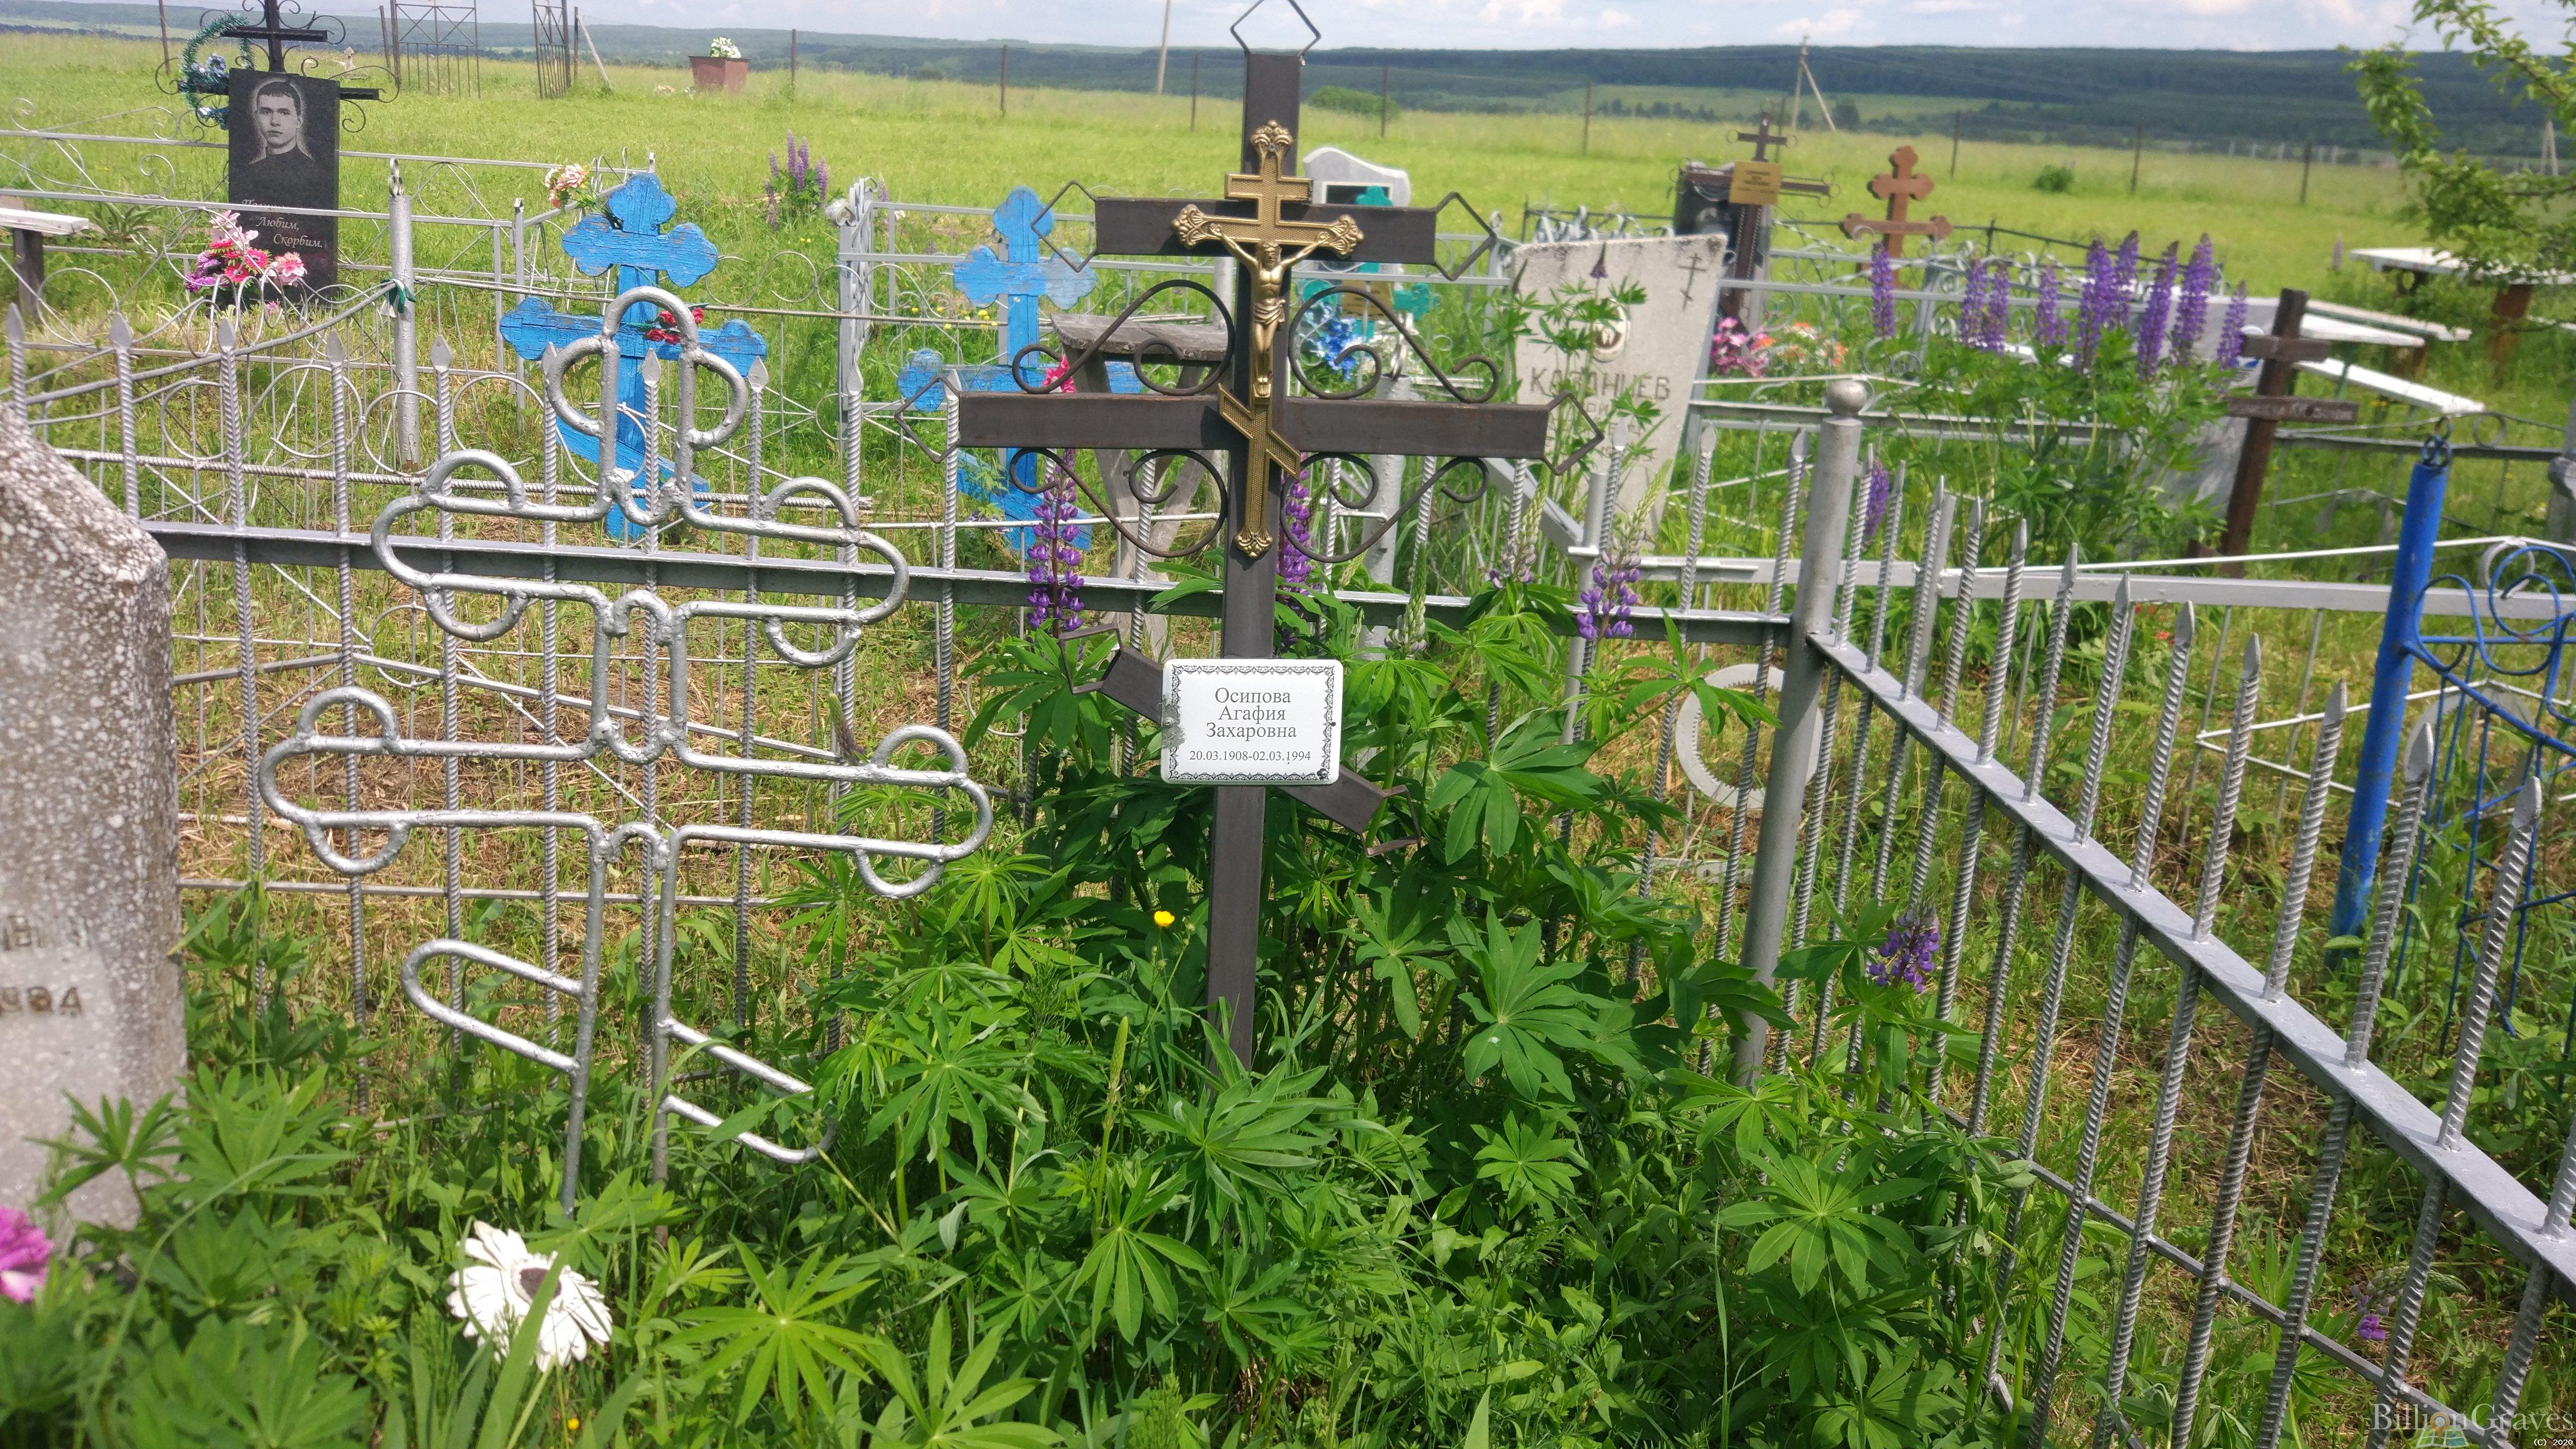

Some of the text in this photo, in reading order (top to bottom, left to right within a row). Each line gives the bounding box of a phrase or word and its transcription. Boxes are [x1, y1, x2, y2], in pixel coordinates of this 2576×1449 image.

[256, 217, 300, 231] Любим,
[273, 234, 323, 248] Скорбим.
[1215, 687, 1291, 704] Осипова
[1218, 705, 1286, 724] Агафия
[1206, 722, 1296, 742] Захаровна
[1189, 750, 1311, 761] 20.03.1908-02.03.1994
